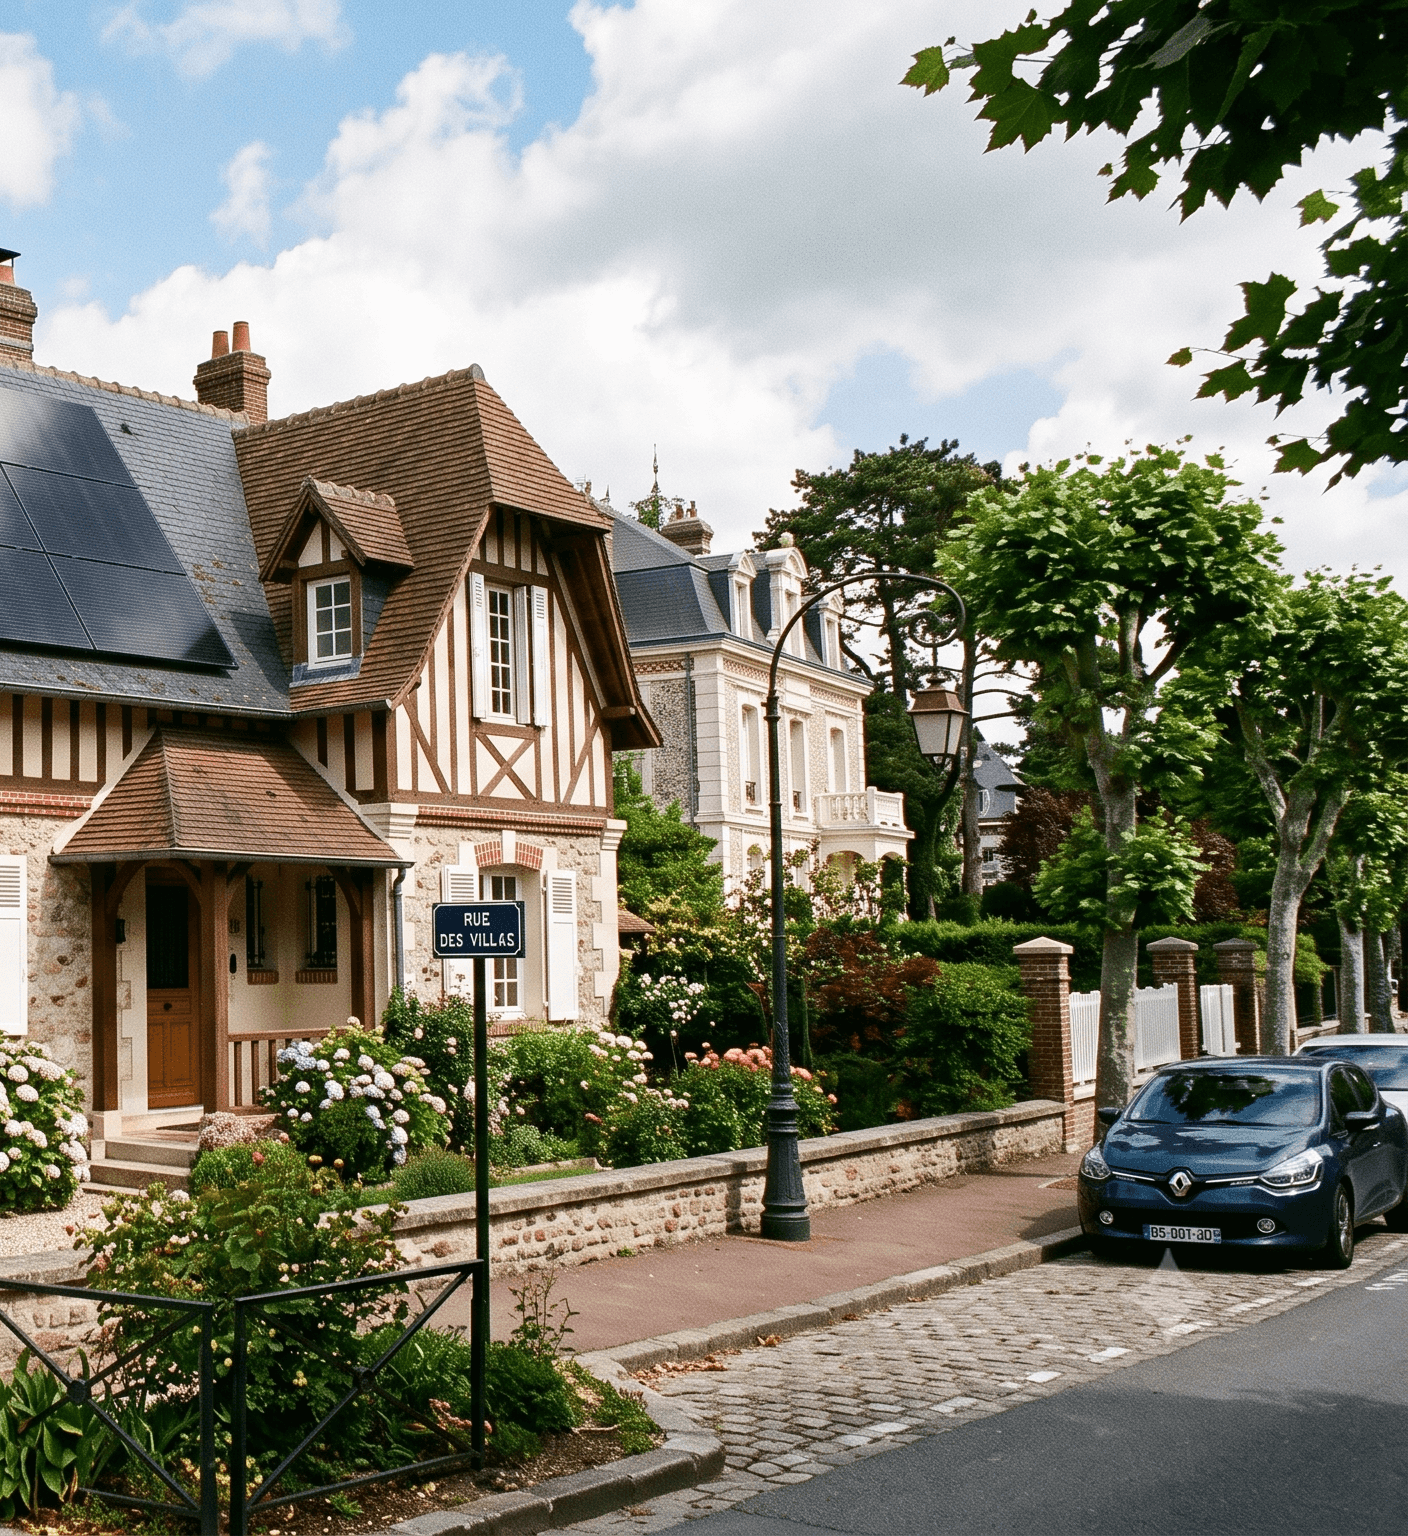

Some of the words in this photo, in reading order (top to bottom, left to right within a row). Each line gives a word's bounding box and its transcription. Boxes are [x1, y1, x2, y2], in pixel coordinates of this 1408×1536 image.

[464, 912, 490, 926] RUE
[440, 933, 463, 947] DES
[470, 933, 515, 947] VILLAS
